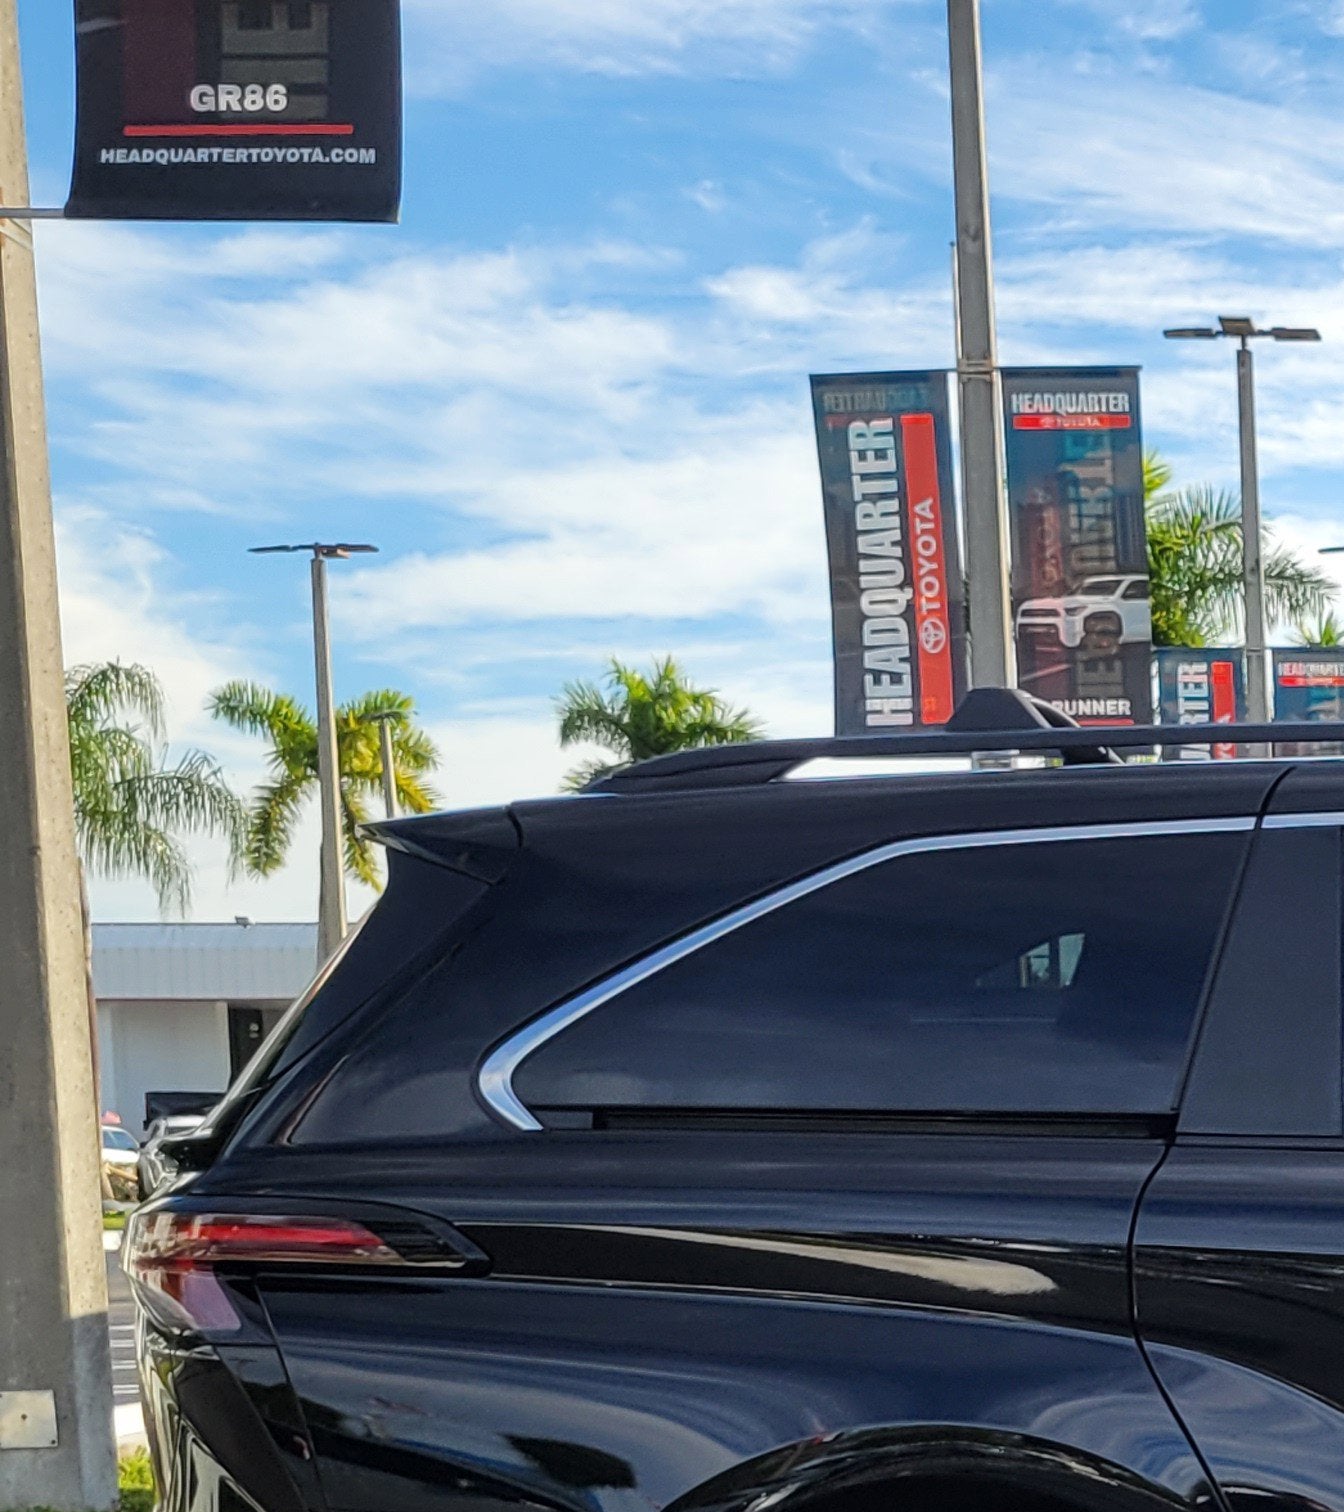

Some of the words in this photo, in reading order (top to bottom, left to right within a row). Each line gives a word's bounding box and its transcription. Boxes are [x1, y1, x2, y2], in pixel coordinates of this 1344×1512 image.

[190, 84, 288, 113] GR86
[100, 147, 376, 165] HEADQUARTERTOYOTA.COM
[1011, 391, 1130, 415] HEADQUARTER
[914, 496, 941, 615] TOYOTA
[848, 416, 914, 727] HEADQUARTER
